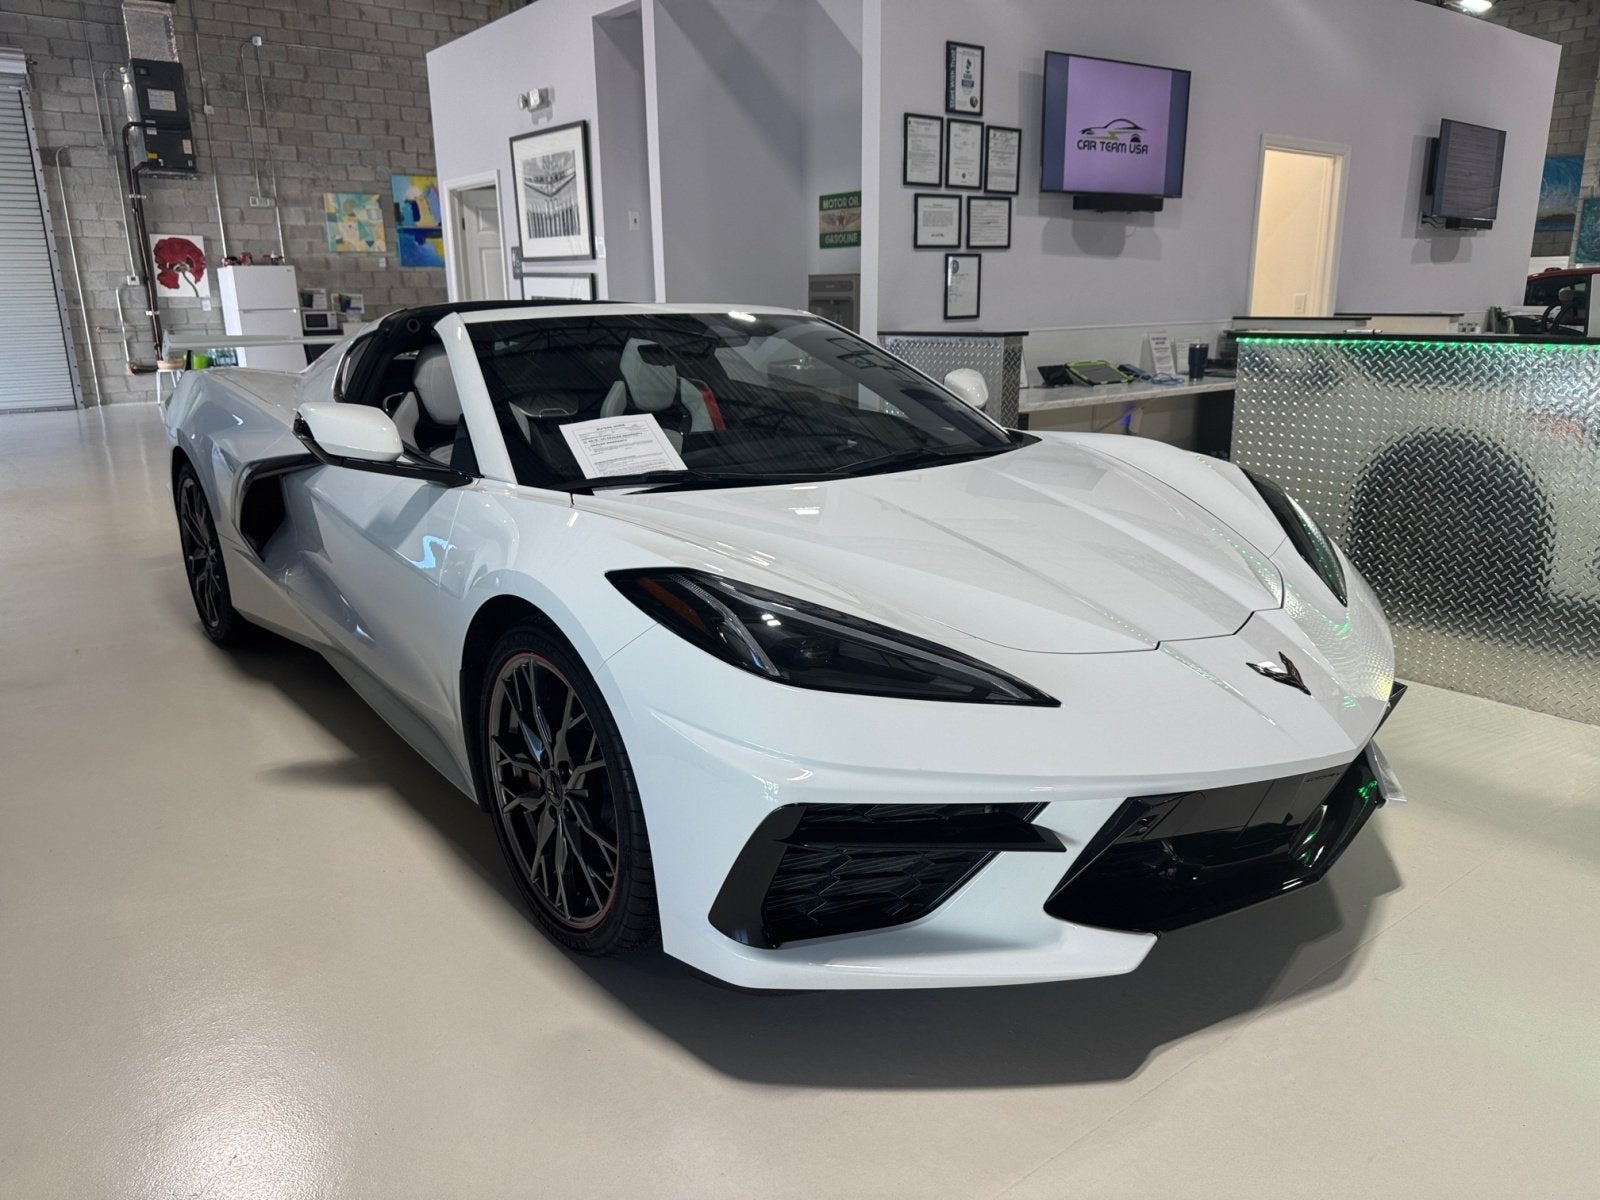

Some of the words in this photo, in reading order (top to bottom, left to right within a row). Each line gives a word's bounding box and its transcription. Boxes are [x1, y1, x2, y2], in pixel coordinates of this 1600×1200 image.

[1077, 139, 1097, 151] CAR
[1100, 141, 1127, 153] TEAM
[1129, 143, 1148, 155] USA
[822, 197, 847, 209] MOTOR
[824, 232, 858, 244] GASOLINE
